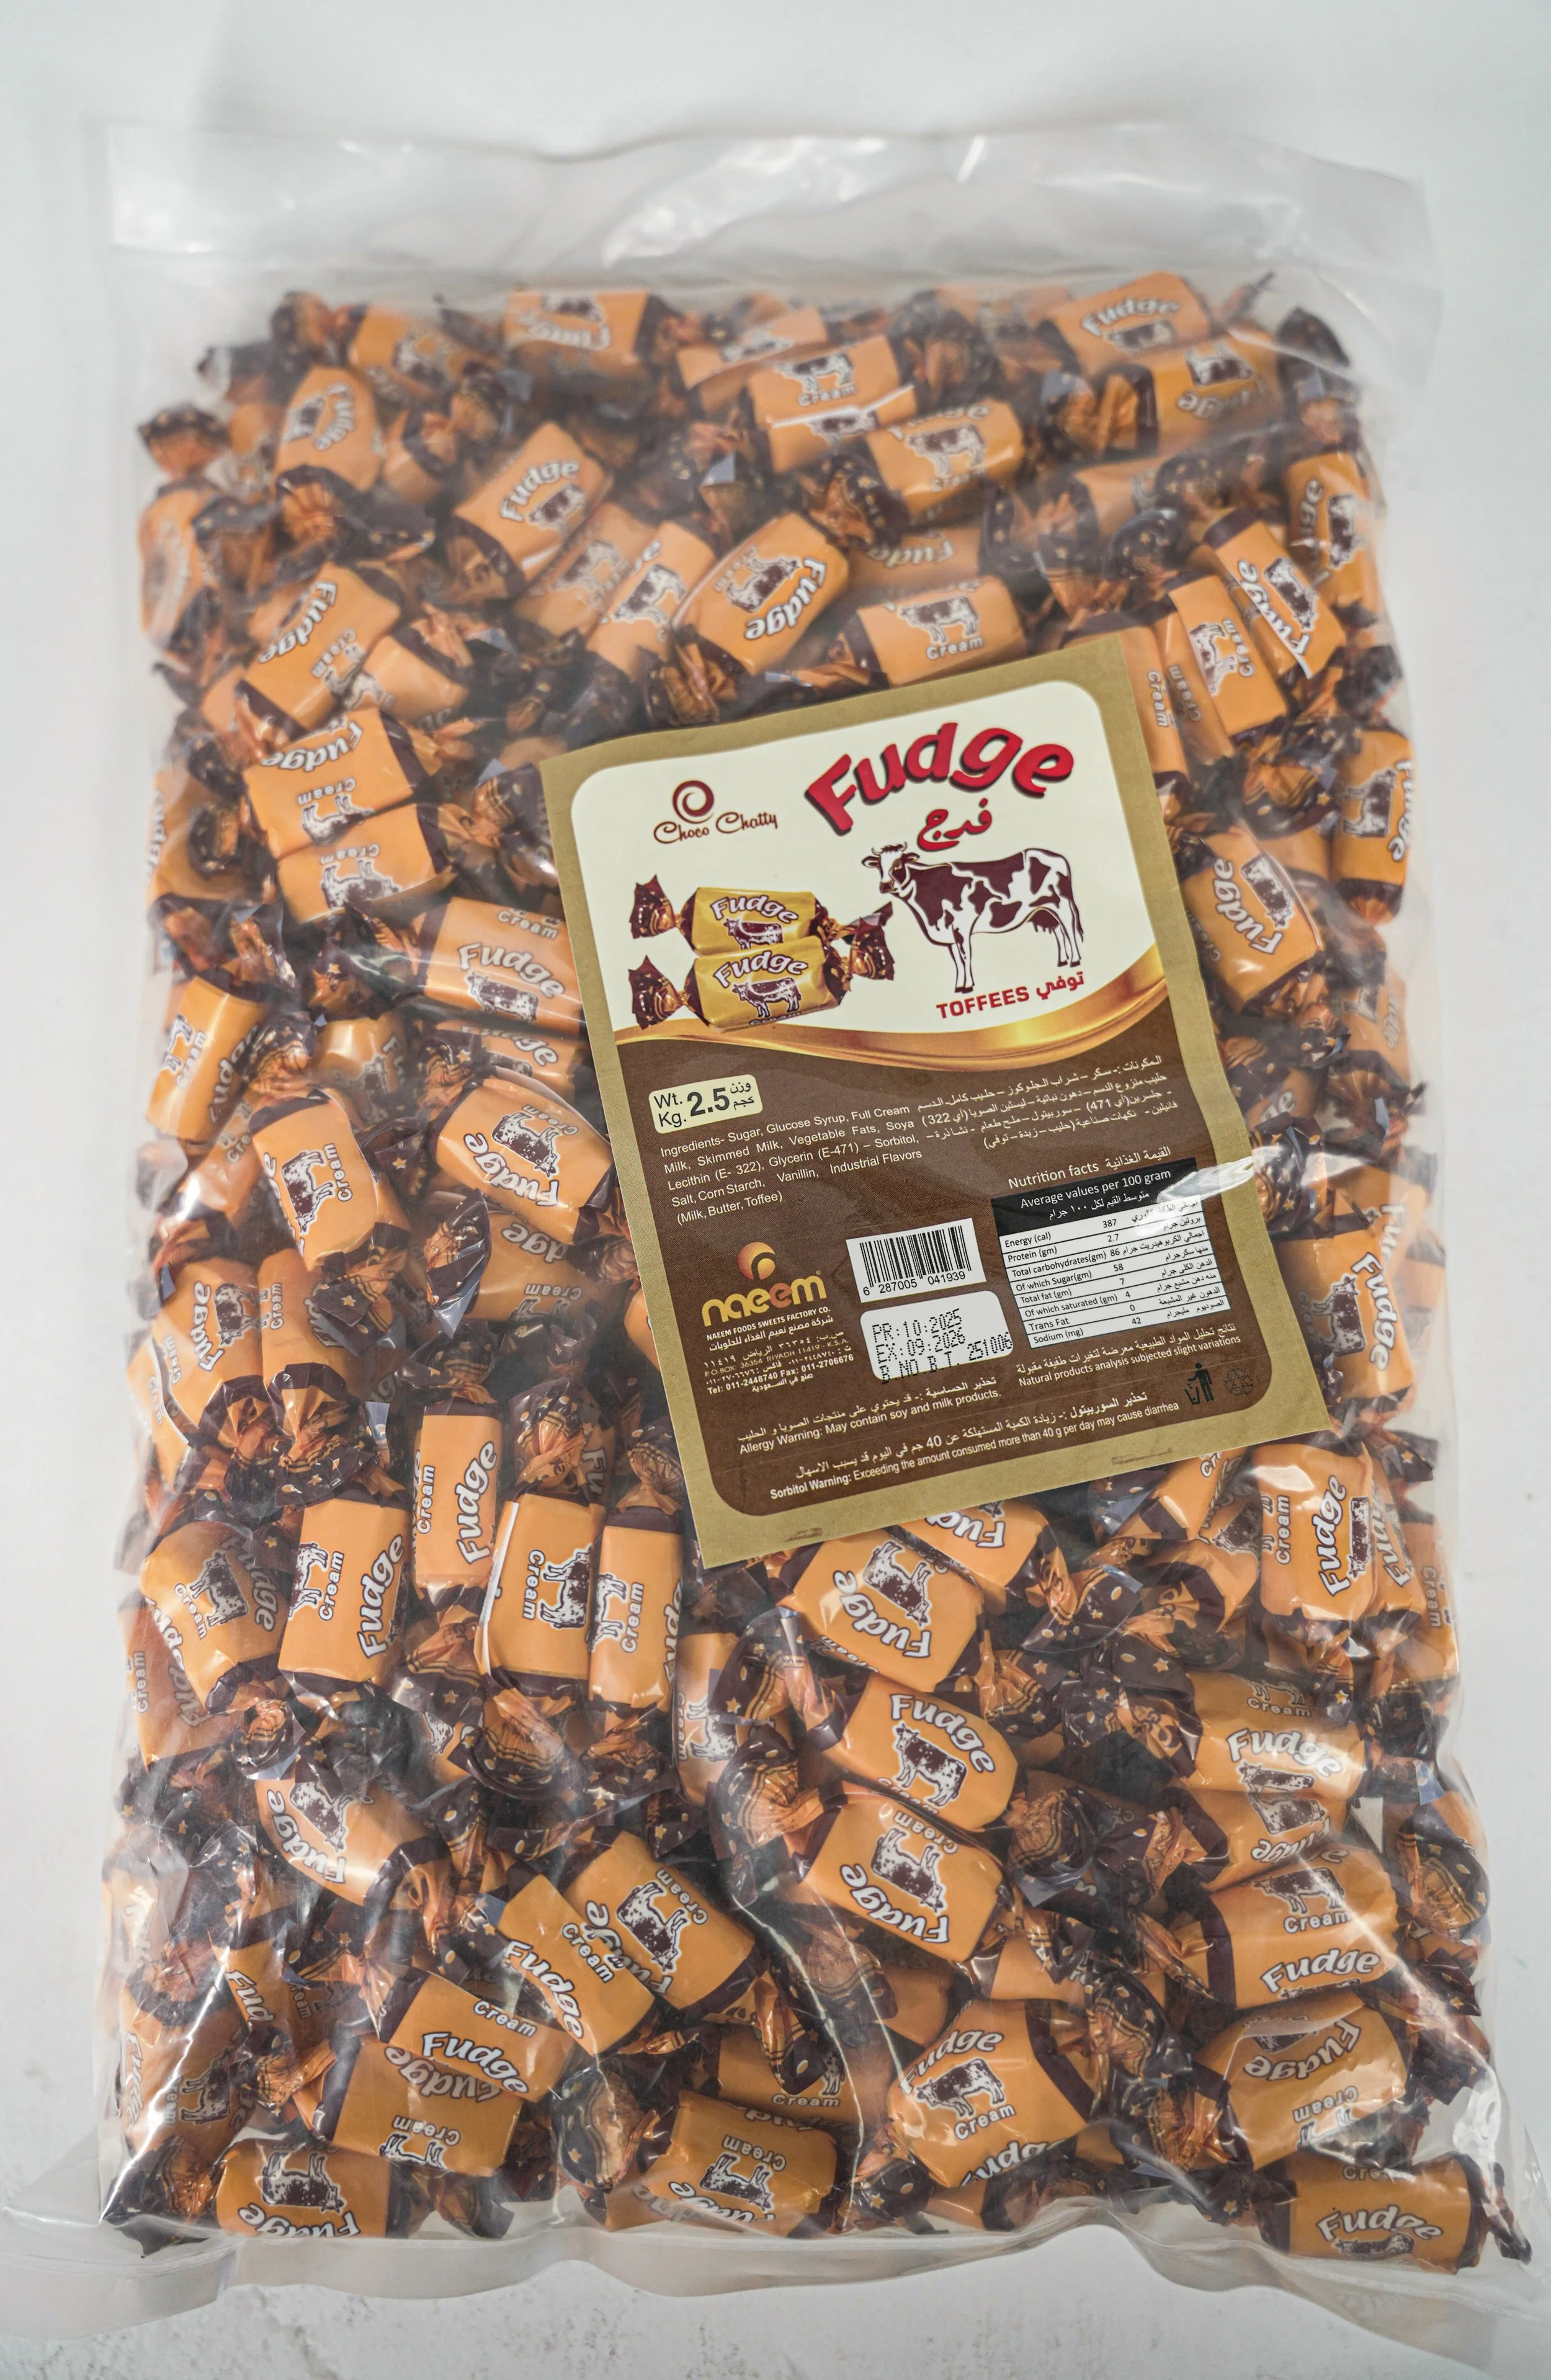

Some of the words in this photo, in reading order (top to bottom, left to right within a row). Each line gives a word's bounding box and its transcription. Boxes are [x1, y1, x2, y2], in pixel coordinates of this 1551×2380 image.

[315, 383, 355, 449] Fudge
[798, 385, 857, 406] Cream
[501, 460, 580, 522] Fudge
[259, 581, 337, 663] Fudge
[745, 557, 827, 641] Fudge
[1238, 559, 1312, 655] Fudge
[311, 629, 355, 677] Cream
[926, 635, 984, 661] Cream
[1223, 619, 1254, 677] Cream
[1148, 670, 1168, 726] Cream
[261, 721, 364, 772] Fudge
[297, 777, 356, 806] Cream
[805, 721, 1075, 836] Fudge
[653, 819, 711, 845] Choco
[715, 811, 778, 832] Chatty
[916, 798, 994, 851] فدج
[320, 844, 380, 863] Cream
[498, 907, 559, 939] Cream
[709, 894, 799, 924] Fudge
[1214, 858, 1282, 955] Fudge
[457, 942, 566, 999] Fudge
[713, 955, 809, 989] Fudge
[1035, 972, 1085, 1003] توفي
[936, 987, 1029, 1020] TOFFEES
[653, 1092, 683, 1109] Wt.
[686, 1086, 730, 1117] 2.5
[730, 1081, 751, 1094] وزن
[733, 1095, 755, 1110] كجم
[521, 1103, 579, 1135] Cream
[658, 1111, 687, 1128] Kg.
[727, 1128, 764, 1143] Sugar,
[766, 1119, 811, 1134] Glucose
[813, 1115, 849, 1126] Syrup,
[851, 1109, 872, 1120] Full
[873, 1106, 910, 1118] Cream
[336, 1143, 354, 1201] Cream
[463, 1131, 560, 1208] Fudge
[663, 1160, 691, 1174] Milk,
[697, 1145, 750, 1166] Skimmed
[756, 1139, 783, 1153] Milk,
[788, 1128, 846, 1146] Vegetable
[851, 1125, 880, 1135] Fats,
[885, 1120, 915, 1131] Soya
[667, 1173, 710, 1191] Lecithin
[735, 1160, 764, 1175] 322),
[768, 1151, 813, 1167] Glycerin
[818, 1141, 859, 1161] (E-471)
[874, 1133, 919, 1148] Sorbitol,
[1104, 1152, 1141, 1170] الغذائية
[1142, 1145, 1171, 1161] القيمة
[671, 1193, 697, 1207] Salt,
[697, 1188, 724, 1201] Corn
[722, 1178, 766, 1196] Starch,
[775, 1168, 819, 1182] Vanillin,
[829, 1154, 880, 1174] Industrial
[882, 1150, 923, 1164] Flavors
[1008, 1170, 1066, 1189] Nutrition
[1068, 1162, 1099, 1177] facts
[1021, 1192, 1064, 1208] Average
[1065, 1185, 1100, 1199] values
[1101, 1180, 1119, 1194] per
[1122, 1174, 1142, 1187] 100
[1143, 1170, 1171, 1185] gram
[677, 1209, 707, 1226] (Milk,
[707, 1201, 744, 1216] Butter,
[743, 1190, 783, 1207] Toffee)
[1004, 1236, 1032, 1248] Energy
[1034, 1231, 1052, 1244] (cal)
[1102, 1218, 1117, 1228] 387
[1007, 1250, 1037, 1264] Protein
[1038, 1245, 1057, 1258] (gm)
[1107, 1232, 1119, 1242] 2.7
[1011, 1266, 1032, 1277] Total
[1032, 1250, 1107, 1273] carbohydrates(gm)
[1109, 1247, 1120, 1257] 86
[269, 1281, 284, 1330] Cream
[702, 1274, 828, 1328] naeem
[862, 1286, 870, 1296] 6
[878, 1278, 918, 1294] 287005
[927, 1270, 966, 1285] 041939
[190, 1280, 225, 1372] Fudge
[706, 1329, 732, 1341] NAEEM
[733, 1322, 757, 1334] FOODS
[757, 1316, 785, 1328] SWEETS
[786, 1308, 817, 1321] FACTORY
[818, 1306, 831, 1314] CO.
[1351, 1252, 1399, 1371] Fudge
[707, 1385, 723, 1395] Tel:
[725, 1371, 778, 1391] 011-2448740
[779, 1367, 799, 1378] Fax:
[800, 1353, 854, 1373] 011-2706676
[740, 1439, 775, 1455] Allergy
[775, 1428, 823, 1445] Warning:
[825, 1422, 847, 1434] May
[849, 1412, 888, 1428] contain
[889, 1408, 908, 1420] soy
[910, 1401, 931, 1415] and
[931, 1397, 954, 1410] milk
[955, 1389, 1001, 1407] products.
[769, 1481, 808, 1500] Sorbitol
[808, 1473, 852, 1491] Warning:
[852, 1463, 900, 1481] Exceeding
[900, 1459, 916, 1470] the
[916, 1450, 951, 1466] amount
[951, 1438, 997, 1458] consumed
[998, 1435, 1021, 1448] more
[1021, 1431, 1042, 1443] than
[1042, 1427, 1054, 1438] 40
[1055, 1427, 1063, 1438] g
[1062, 1424, 1077, 1437] per
[1078, 1420, 1095, 1431] day
[1096, 1415, 1115, 1427] may
[1116, 1409, 1143, 1422] cause
[1143, 1402, 1180, 1416] diarrhea
[417, 1464, 435, 1535] Cream
[457, 1440, 498, 1566] Fudge
[1277, 1494, 1290, 1566] Cream
[1318, 1474, 1351, 1597] Fudge
[318, 1551, 344, 1621] Cream
[357, 1535, 404, 1660] Fudge
[522, 1549, 545, 1620] Cream
[173, 1582, 208, 1640] Cream
[621, 1582, 645, 1654] Cream
[833, 1569, 931, 1659] Fudge
[1246, 1695, 1312, 1719] Cream
[890, 1693, 996, 1774] Fudge
[1227, 1728, 1344, 1778] Fudge
[266, 1789, 347, 1886] Fudge
[893, 1810, 960, 1855] Cream
[655, 1868, 708, 1926] Cream
[841, 1862, 950, 1945] Fudge
[1284, 1909, 1353, 1935] Cream
[561, 1922, 615, 1984] Cream
[1259, 1948, 1380, 1994] Fudge
[502, 1939, 585, 2040] Fudge
[473, 2000, 537, 2037] Cream
[421, 2031, 530, 2095] Fudge
[898, 2028, 1004, 2095] Fudge
[1243, 2014, 1362, 2083] Fudge
[771, 2093, 840, 2108] Cream
[954, 2102, 1017, 2142] Cream
[1292, 2084, 1359, 2124] Cream
[394, 2115, 460, 2146] Cream
[721, 2135, 787, 2172] Cream
